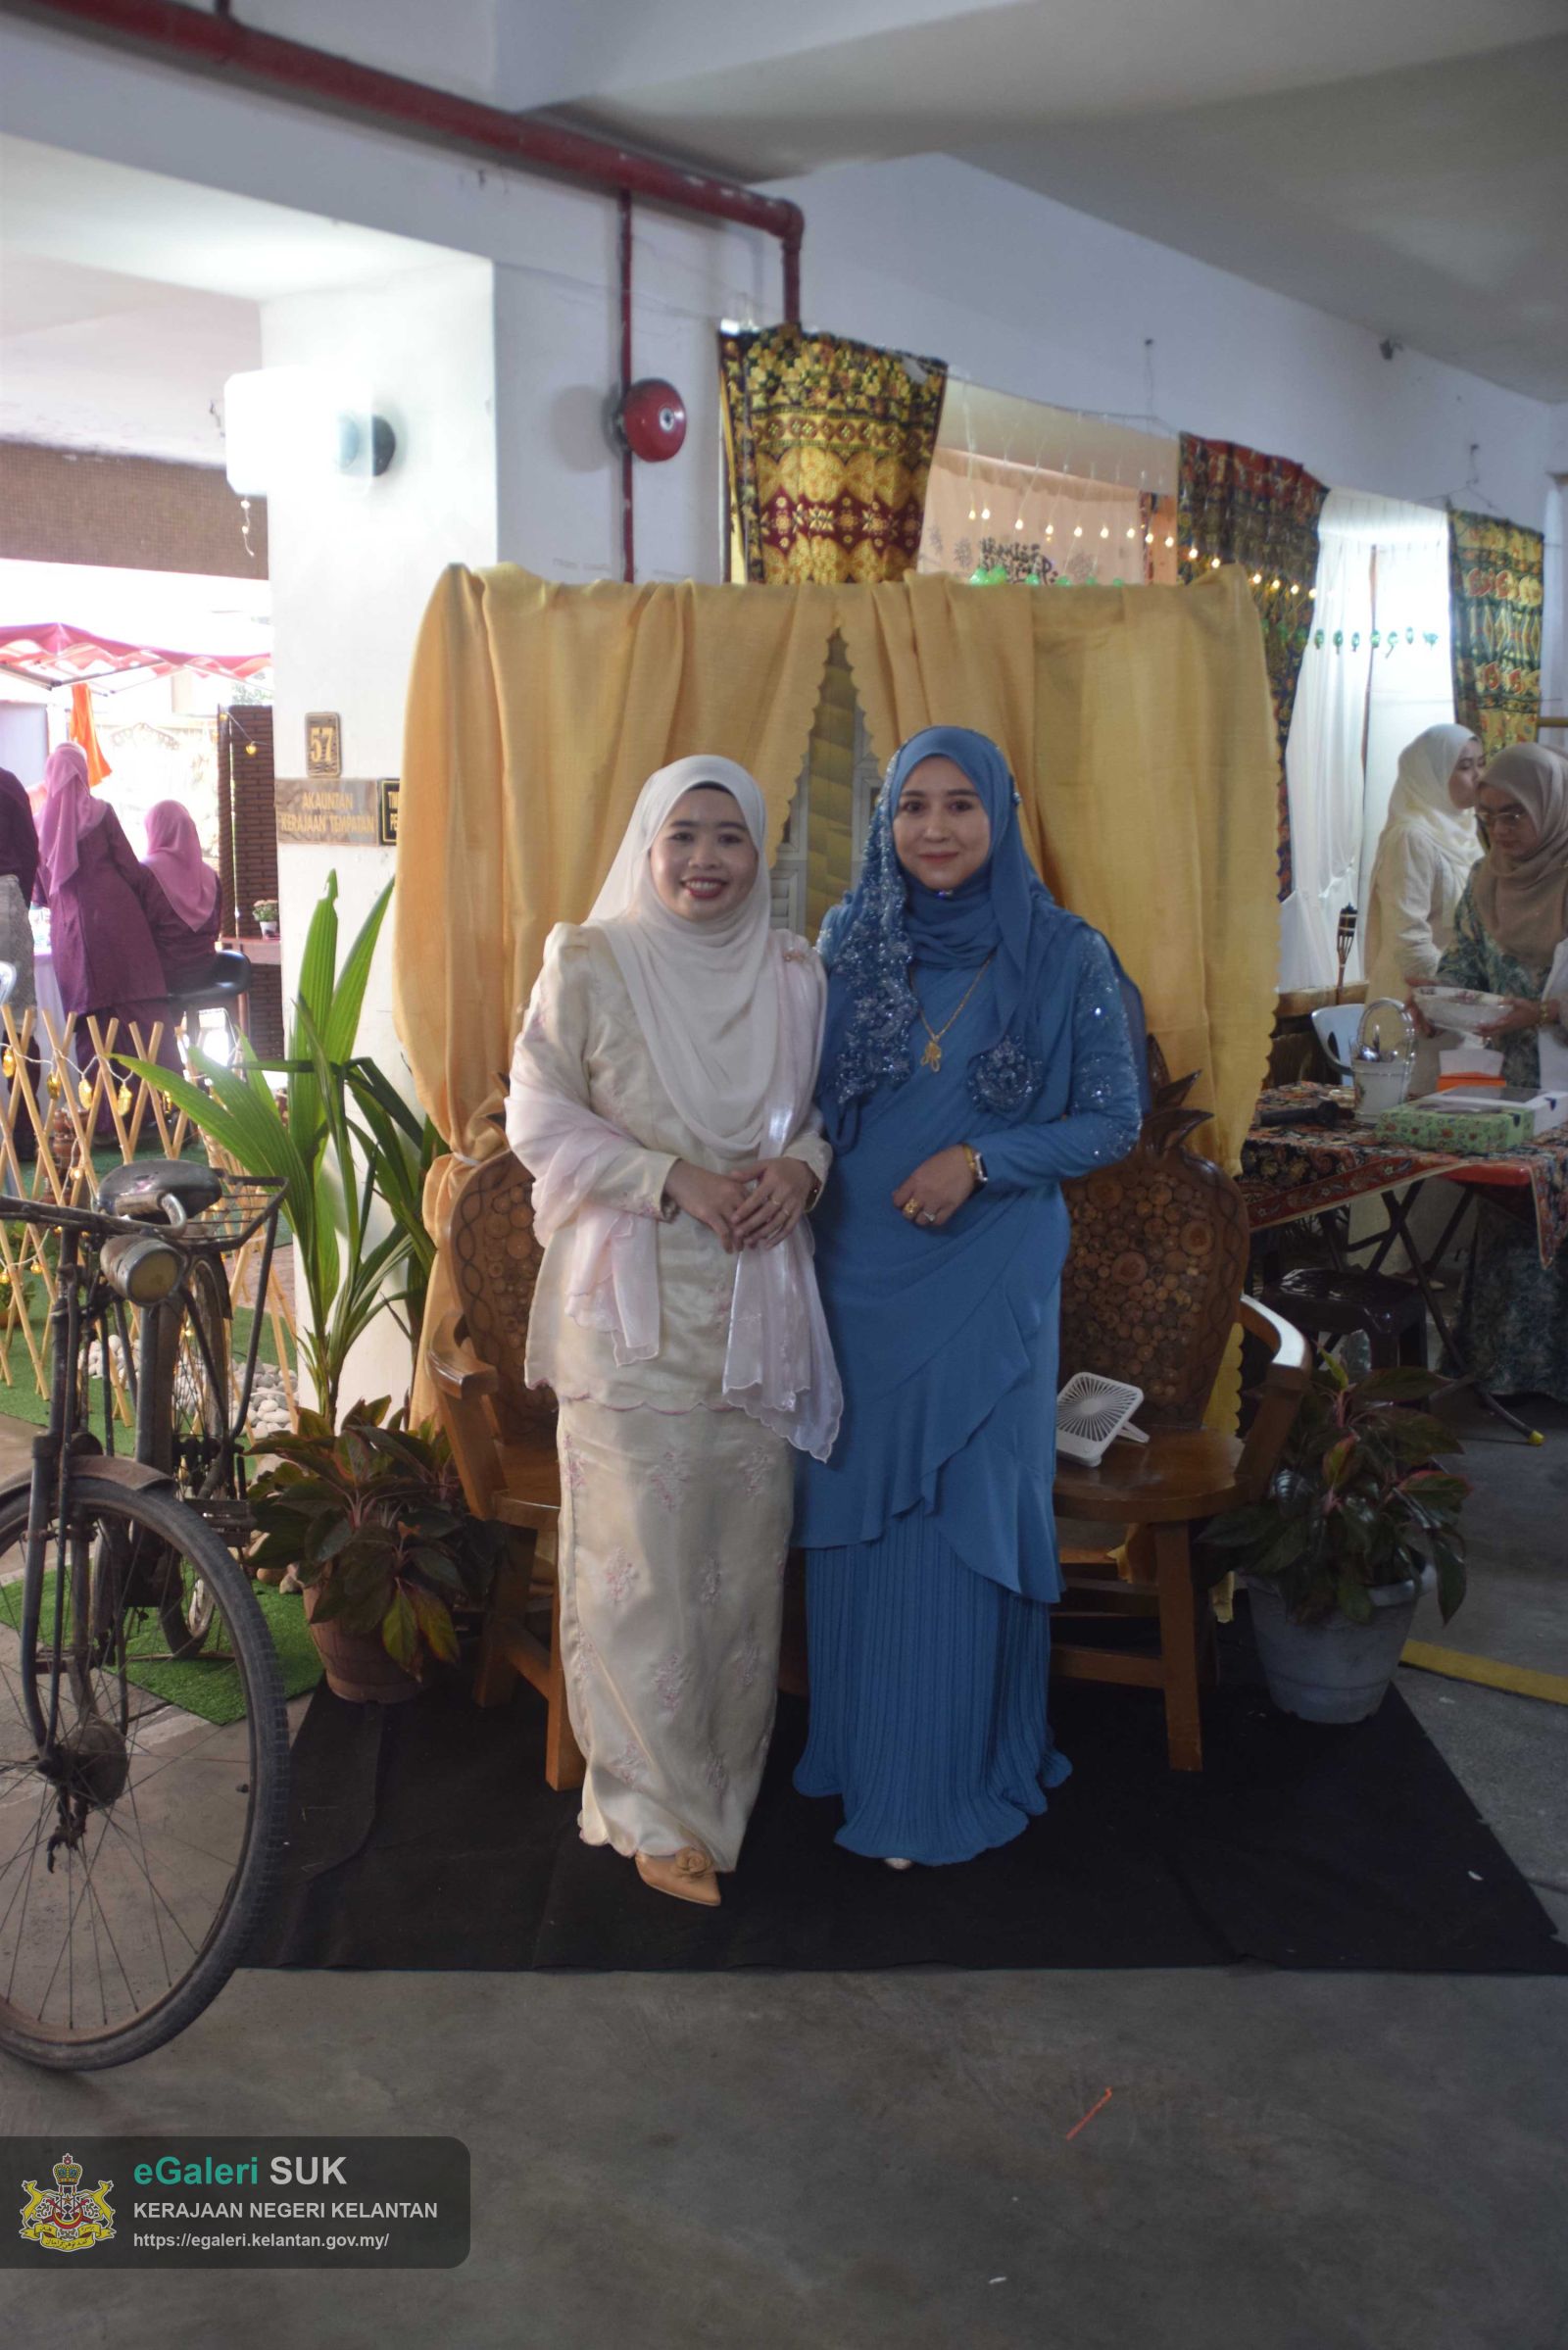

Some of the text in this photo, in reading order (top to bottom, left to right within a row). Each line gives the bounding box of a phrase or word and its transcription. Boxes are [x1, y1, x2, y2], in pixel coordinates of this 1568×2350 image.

[310, 726, 335, 763] 57
[301, 791, 354, 810] AKAUNTAN
[280, 814, 326, 832] KERAJAAN
[329, 814, 375, 832] TEMPATAN
